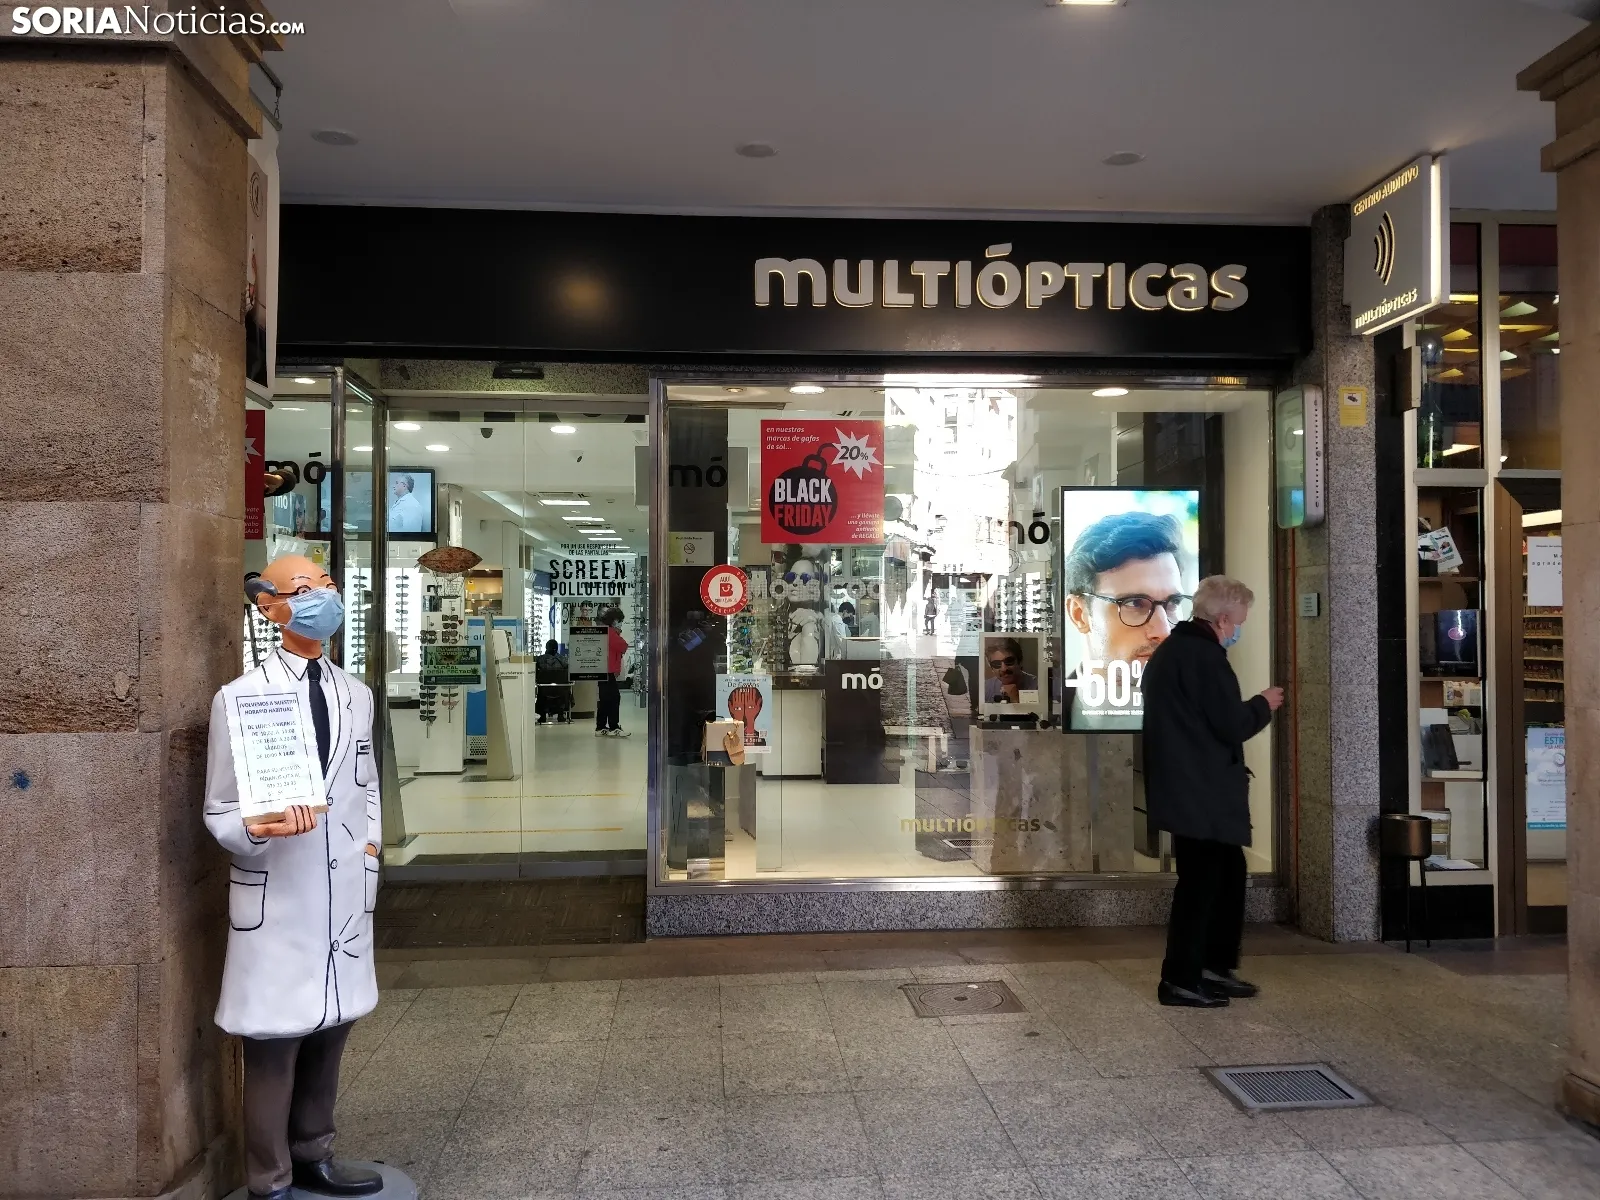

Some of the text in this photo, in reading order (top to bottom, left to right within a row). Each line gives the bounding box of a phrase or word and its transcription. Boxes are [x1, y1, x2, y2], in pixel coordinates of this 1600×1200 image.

[1353, 165, 1419, 216] CENTRO AUDITIVO
[800, 435, 820, 444] gafas
[838, 446, 869, 460] 20%
[774, 478, 832, 502] BLACK
[774, 504, 832, 527] FRIDAY
[549, 559, 626, 580] SCREEN
[549, 581, 626, 596] POLLUTION
[841, 666, 884, 690] mó
